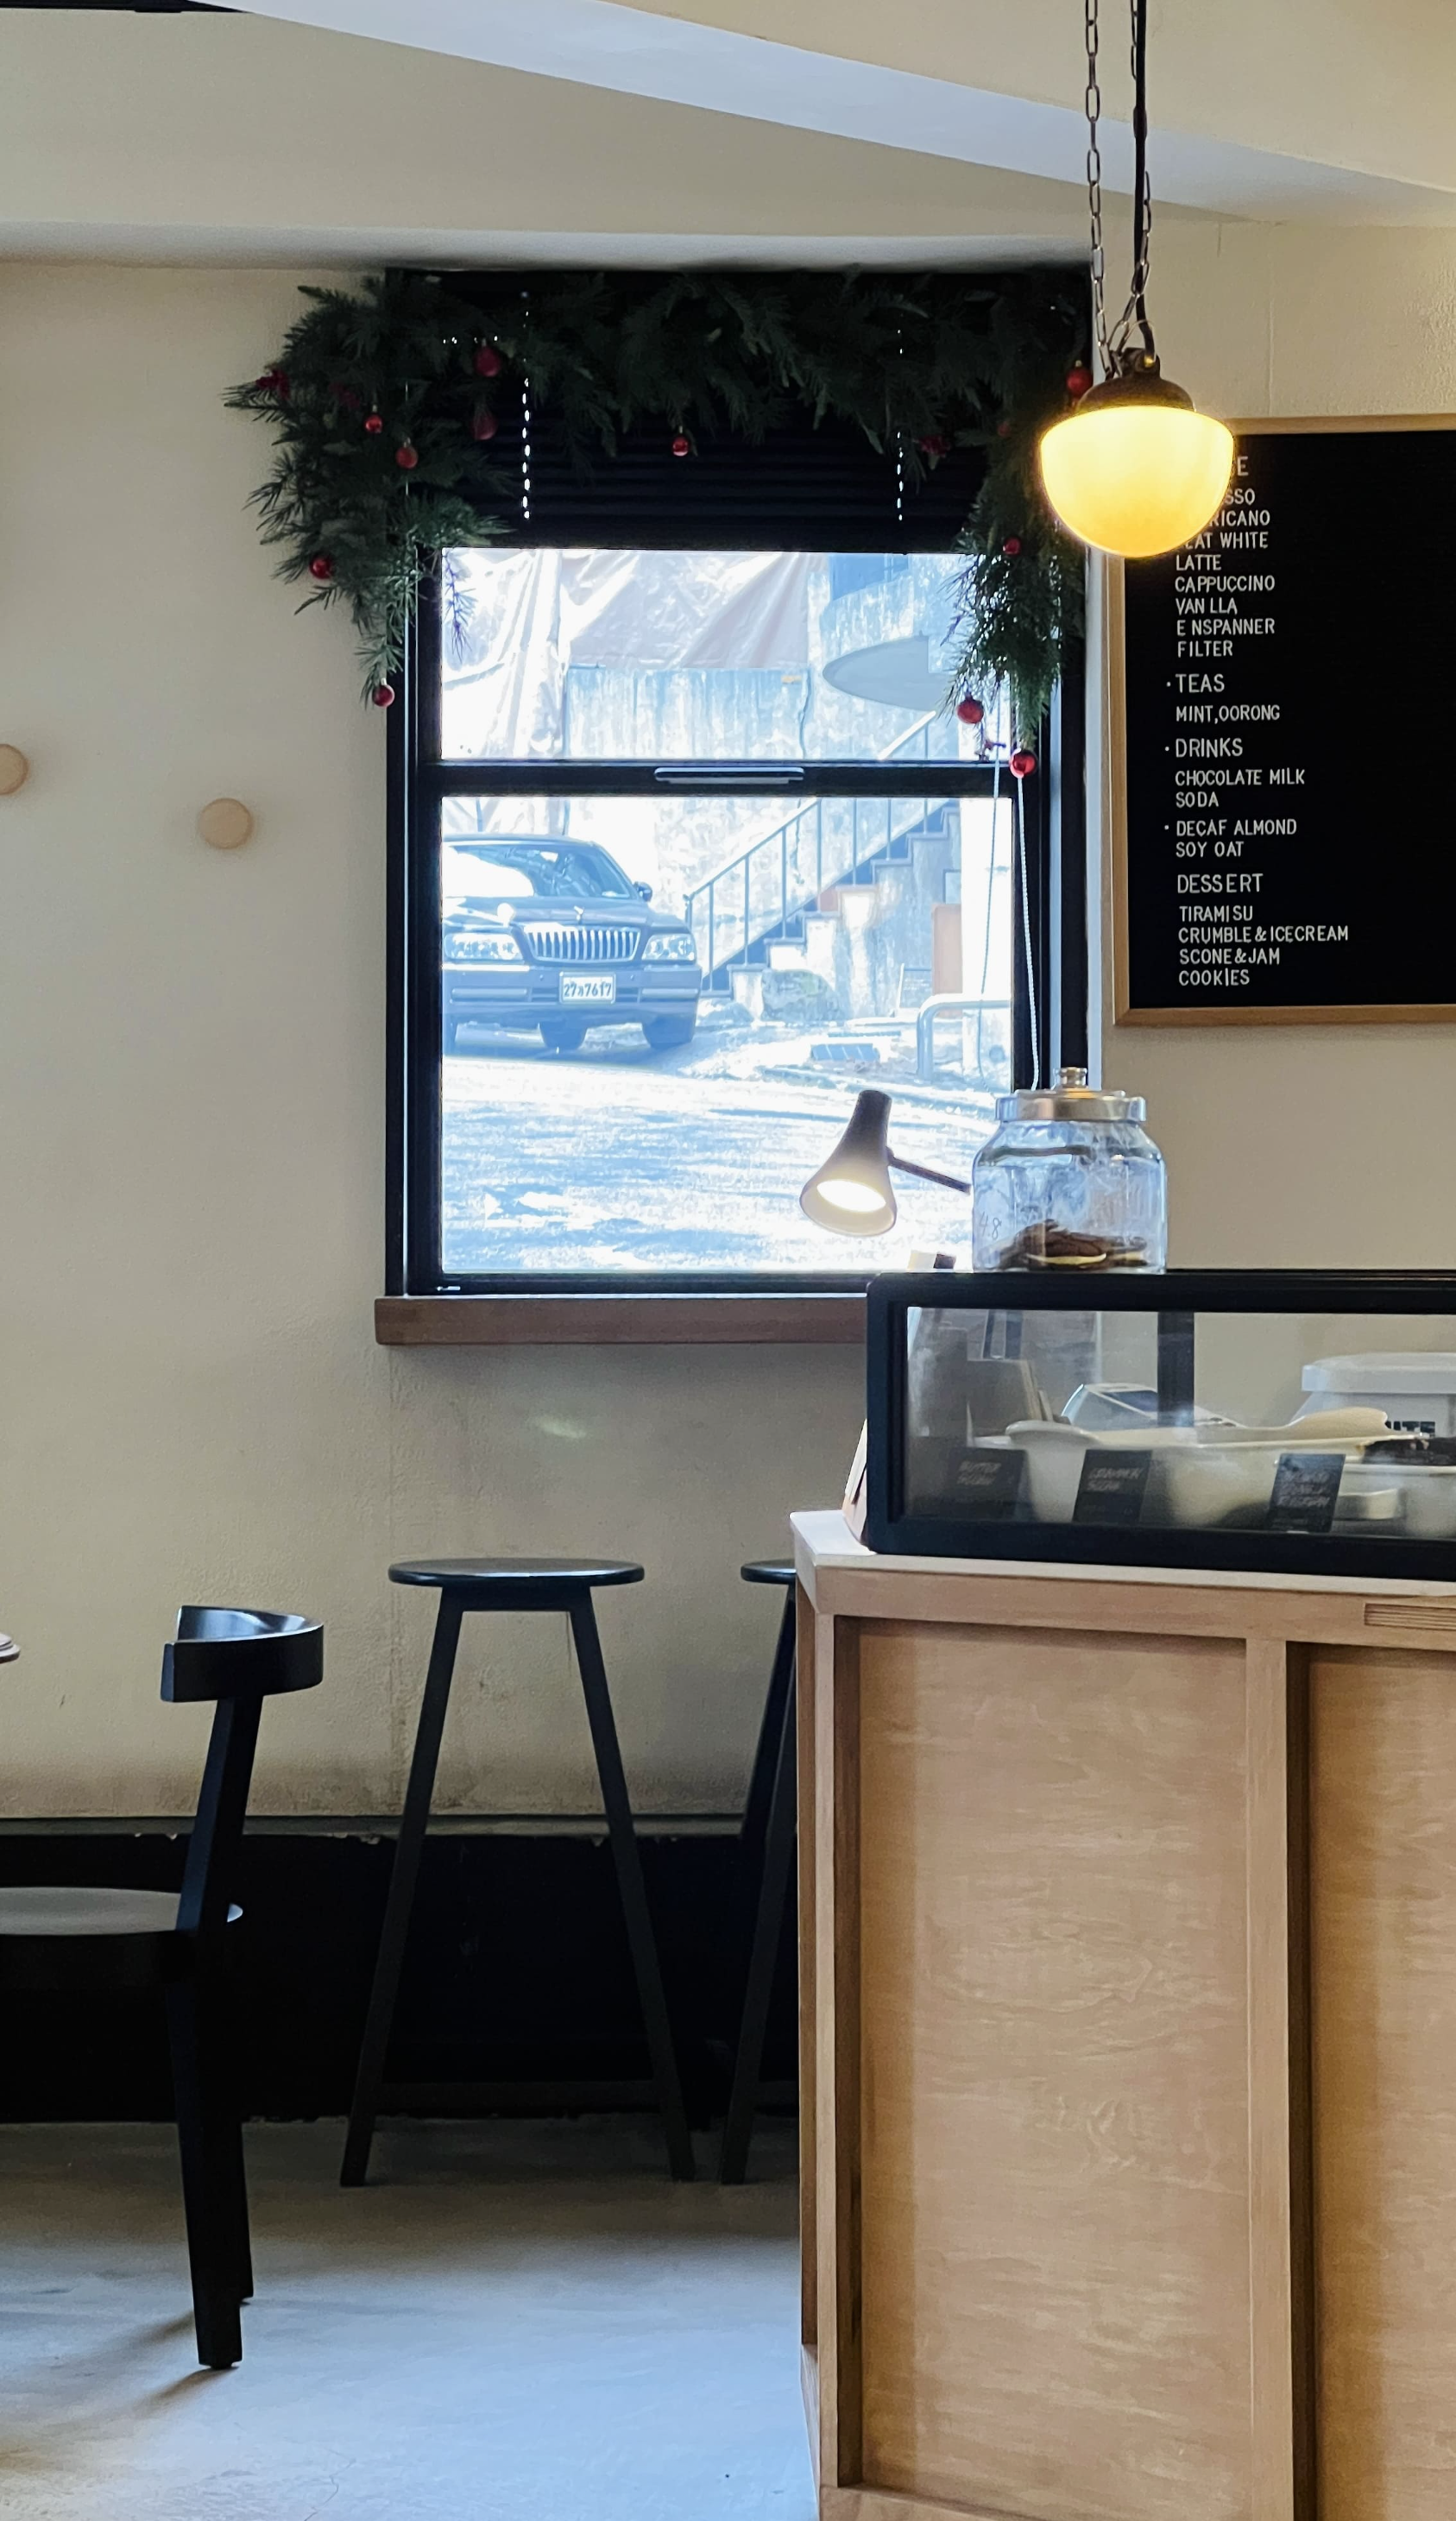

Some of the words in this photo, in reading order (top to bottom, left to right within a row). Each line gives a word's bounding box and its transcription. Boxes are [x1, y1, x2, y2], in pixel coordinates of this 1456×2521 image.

[1208, 507, 1271, 528] RICANO
[1220, 530, 1270, 550] WHITE
[1175, 553, 1223, 572] LATTE
[1174, 574, 1276, 595] CAPPUCCINO
[1176, 640, 1234, 659] FILTER
[1174, 673, 1226, 693] TEAS
[1175, 738, 1244, 758] DRINKS
[1174, 769, 1264, 787] CHOCOLATE
[1269, 767, 1306, 786] MILK
[1175, 790, 1220, 809] SODA
[1176, 820, 1228, 837] DECAF
[1232, 818, 1298, 836] ALMOND
[1175, 841, 1207, 859] SOY
[1213, 840, 1245, 858] OAT
[1176, 872, 1264, 894] DESSERT
[1178, 904, 1254, 923] TIRAMISU
[1177, 967, 1251, 987] COOKIES
